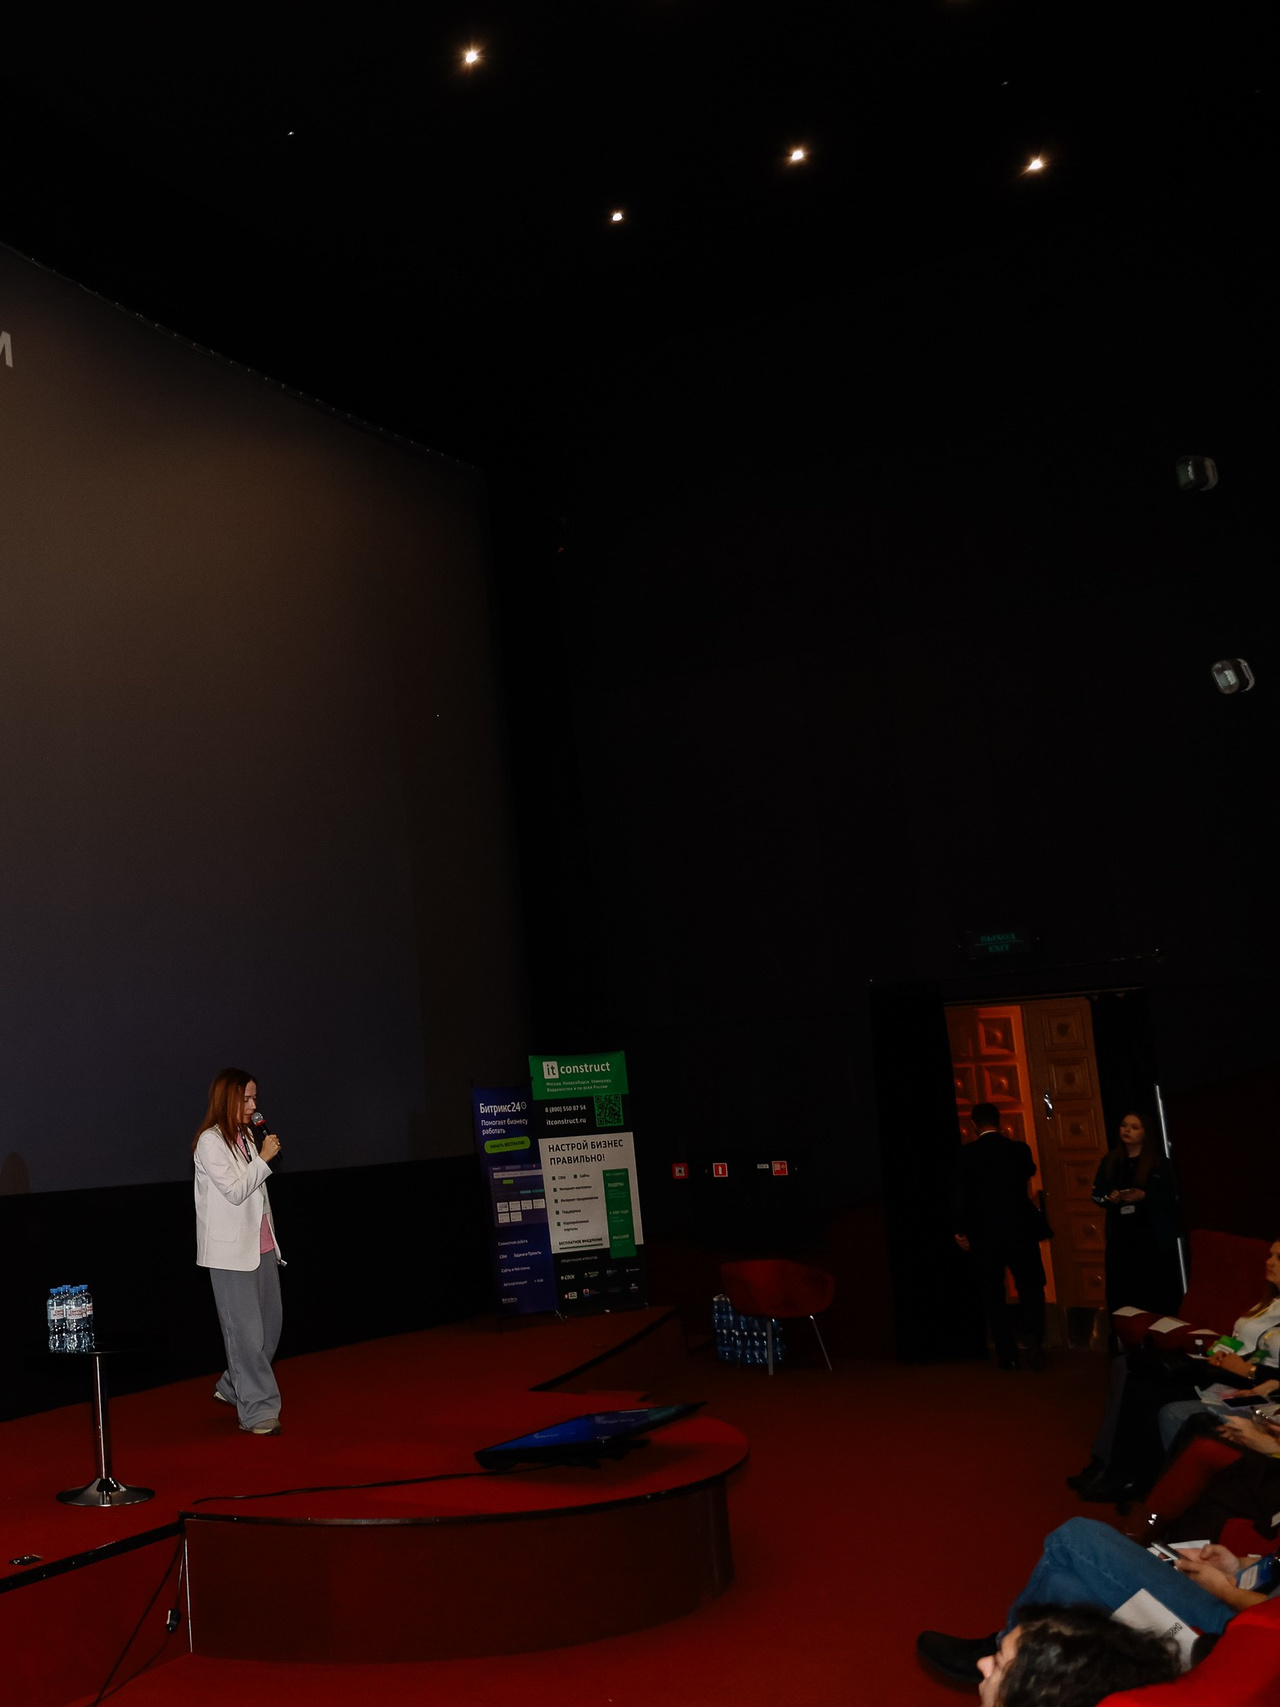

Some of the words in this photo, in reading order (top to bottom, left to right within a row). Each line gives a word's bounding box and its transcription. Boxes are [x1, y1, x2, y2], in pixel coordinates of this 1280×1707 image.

[988, 944, 1011, 953] EXIT
[546, 1064, 556, 1076] it
[560, 1062, 611, 1074] construct
[479, 1101, 521, 1116] Битрикс24
[507, 1118, 529, 1126] бизнесу
[482, 1128, 506, 1136] работать
[548, 1140, 589, 1152] НАСТРОЙ
[591, 1139, 623, 1149] БИЗНЕС
[550, 1154, 605, 1165] ПРАВИЛЬНО!
